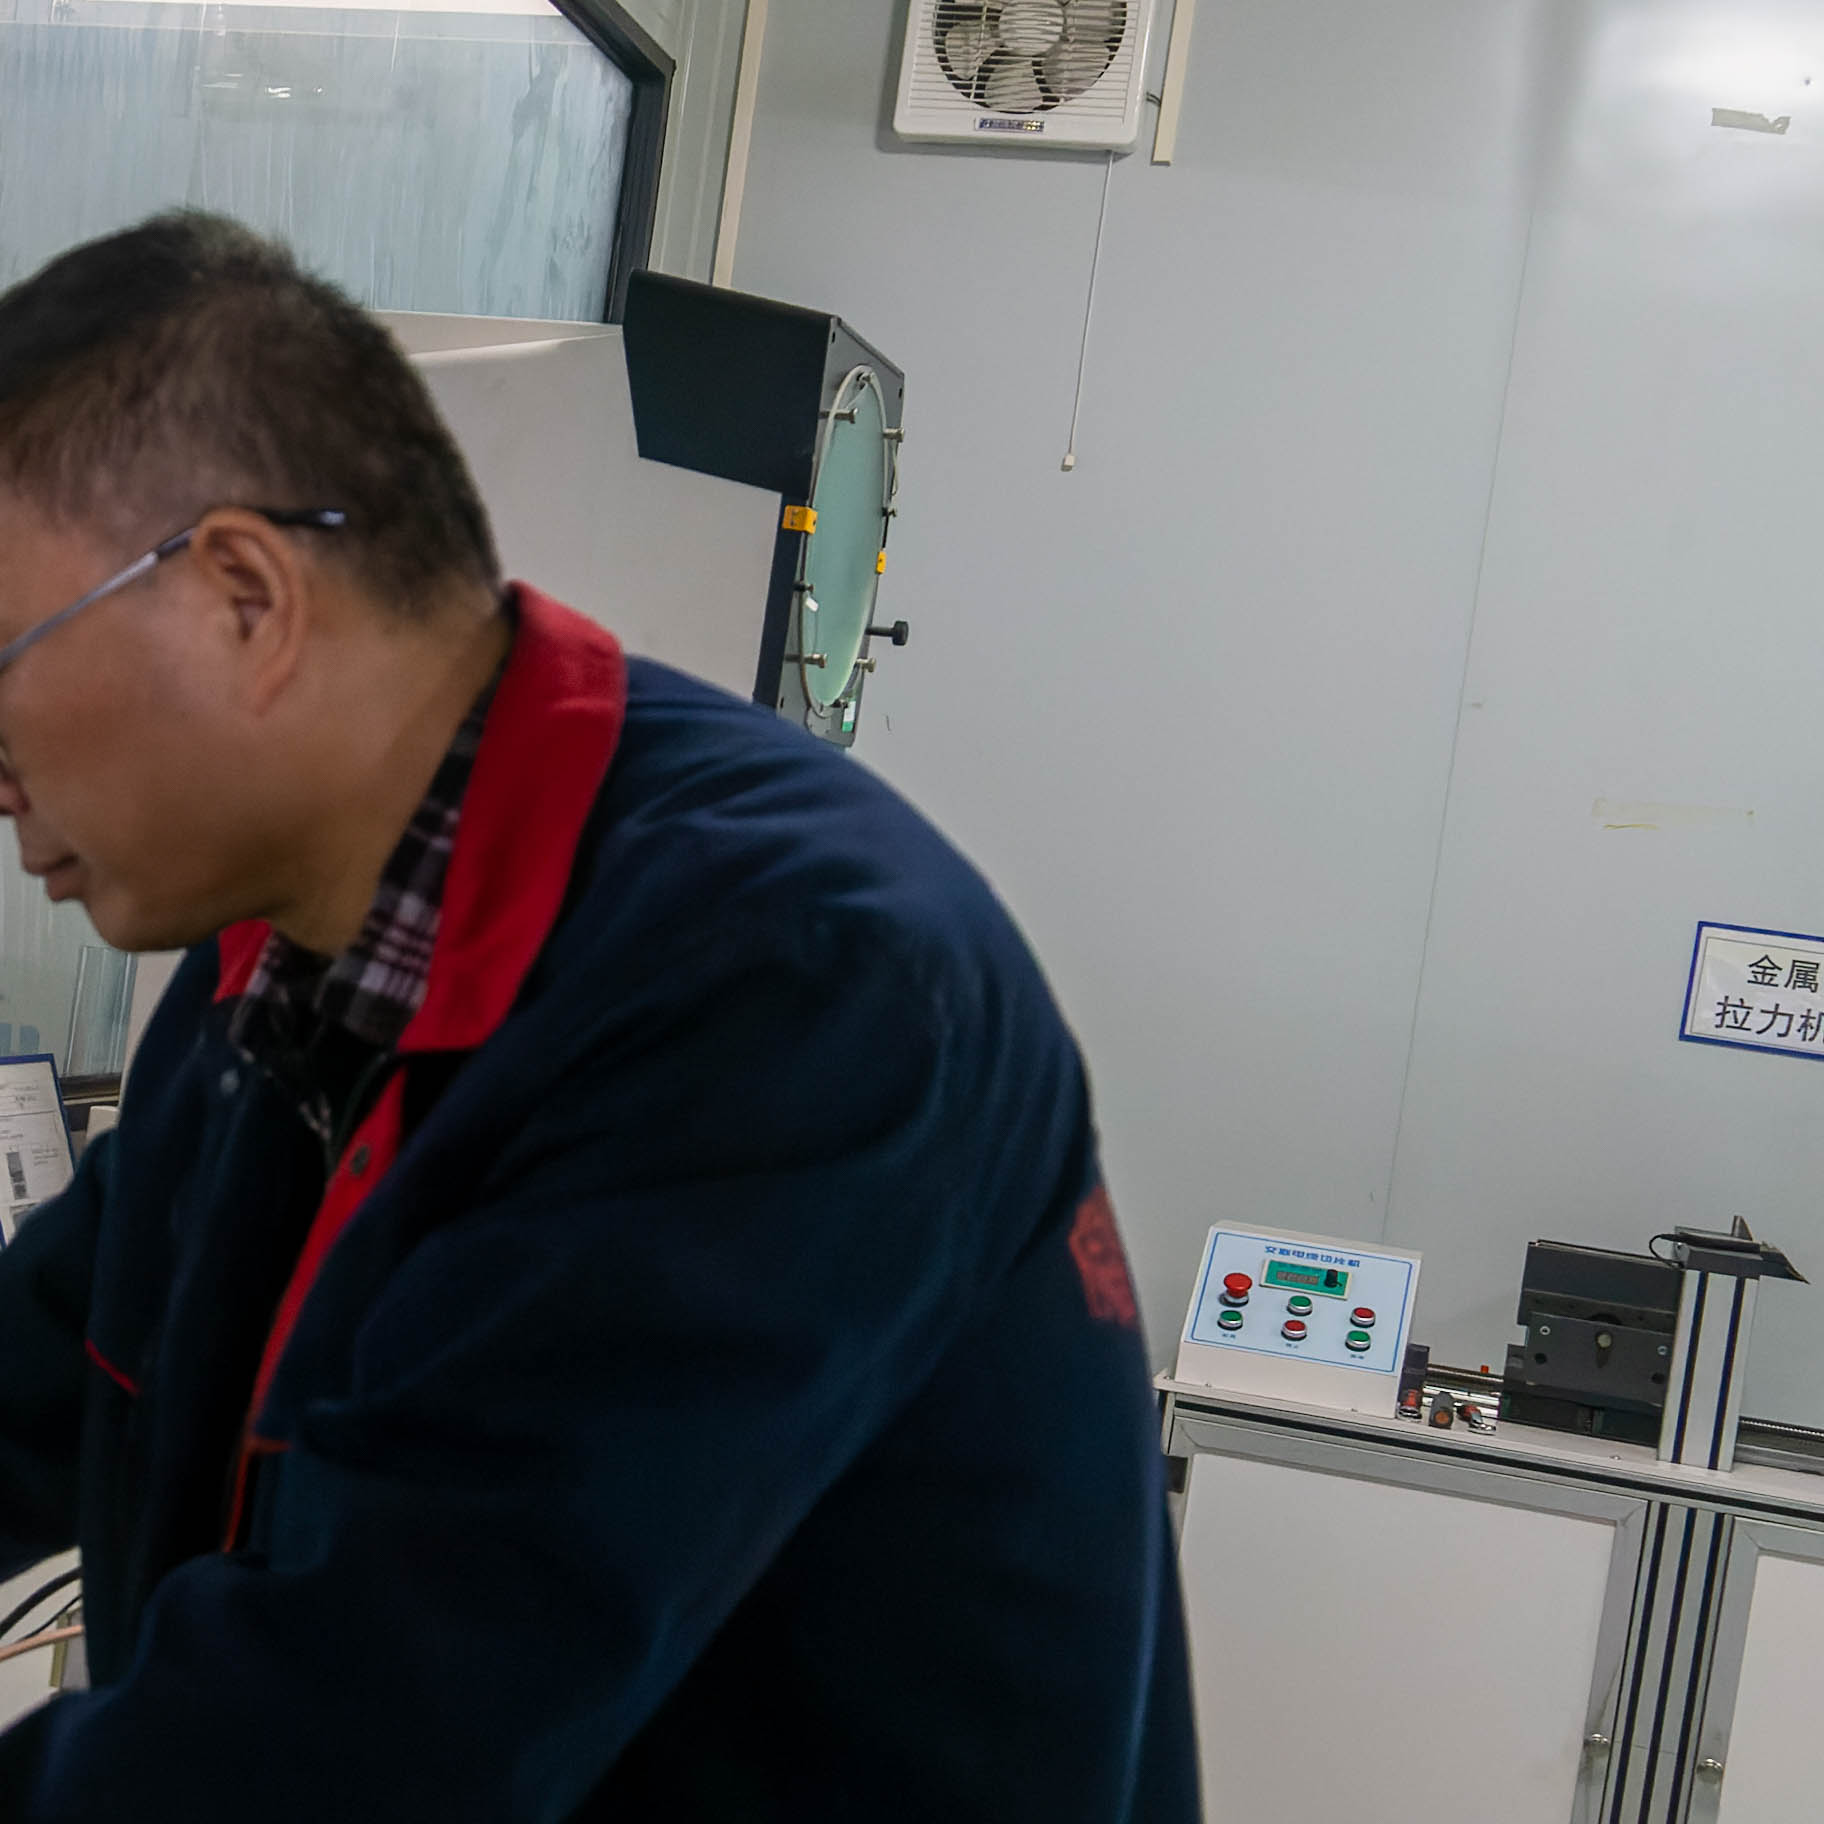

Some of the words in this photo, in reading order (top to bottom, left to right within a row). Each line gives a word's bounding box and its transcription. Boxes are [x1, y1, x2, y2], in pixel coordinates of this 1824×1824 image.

[1747, 954, 1821, 994] 金属
[1714, 995, 1824, 1044] 拉力机
